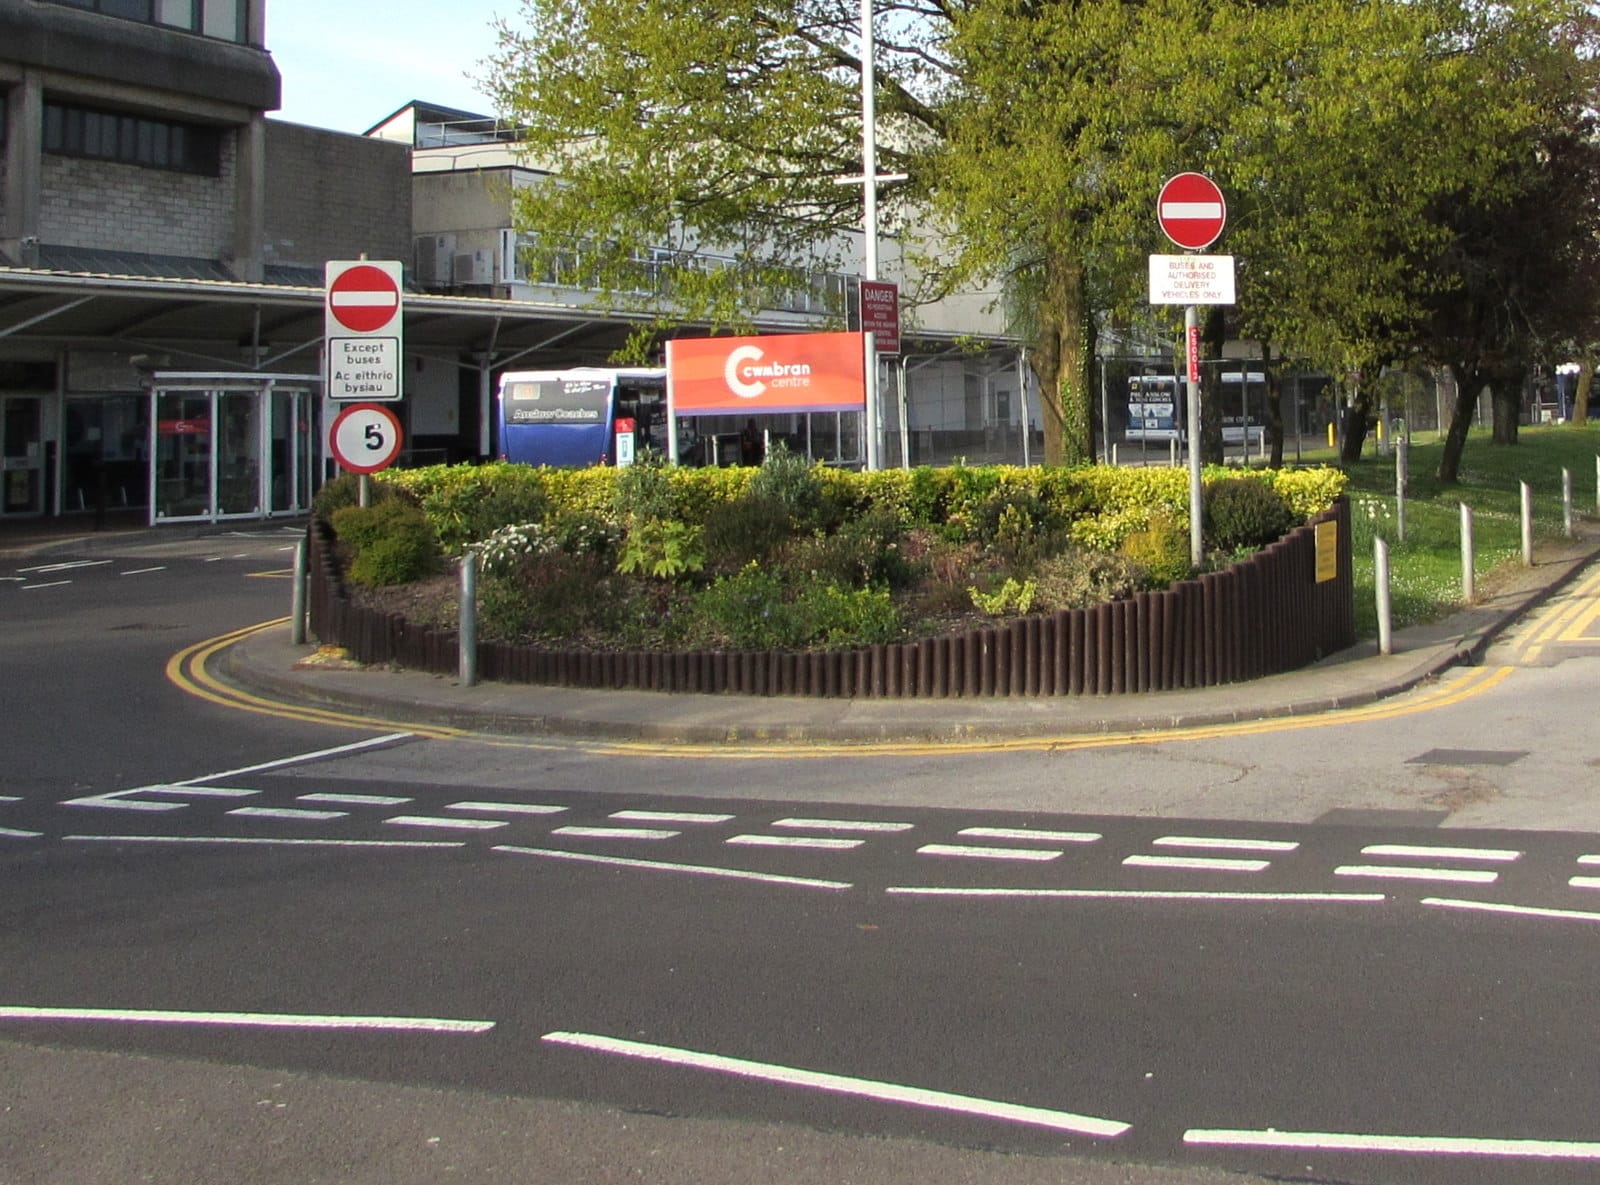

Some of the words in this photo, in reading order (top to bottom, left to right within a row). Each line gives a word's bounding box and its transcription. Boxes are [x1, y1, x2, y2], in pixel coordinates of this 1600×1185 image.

[1169, 262, 1195, 270] BUSES
[1198, 262, 1214, 270] AND
[1168, 272, 1216, 280] AUTHORISED
[1173, 281, 1210, 289] DELIVERY
[865, 289, 894, 303] DANGER
[1162, 291, 1200, 299] VEHICLES
[1203, 291, 1222, 299] ONLY
[344, 342, 384, 354] Except
[347, 354, 381, 365] buses
[335, 370, 350, 381] Ac
[355, 369, 394, 381] eithrio
[743, 361, 811, 377] cwmbran
[345, 382, 383, 394] bysiau
[771, 377, 811, 389] centre
[364, 424, 385, 450] 5
